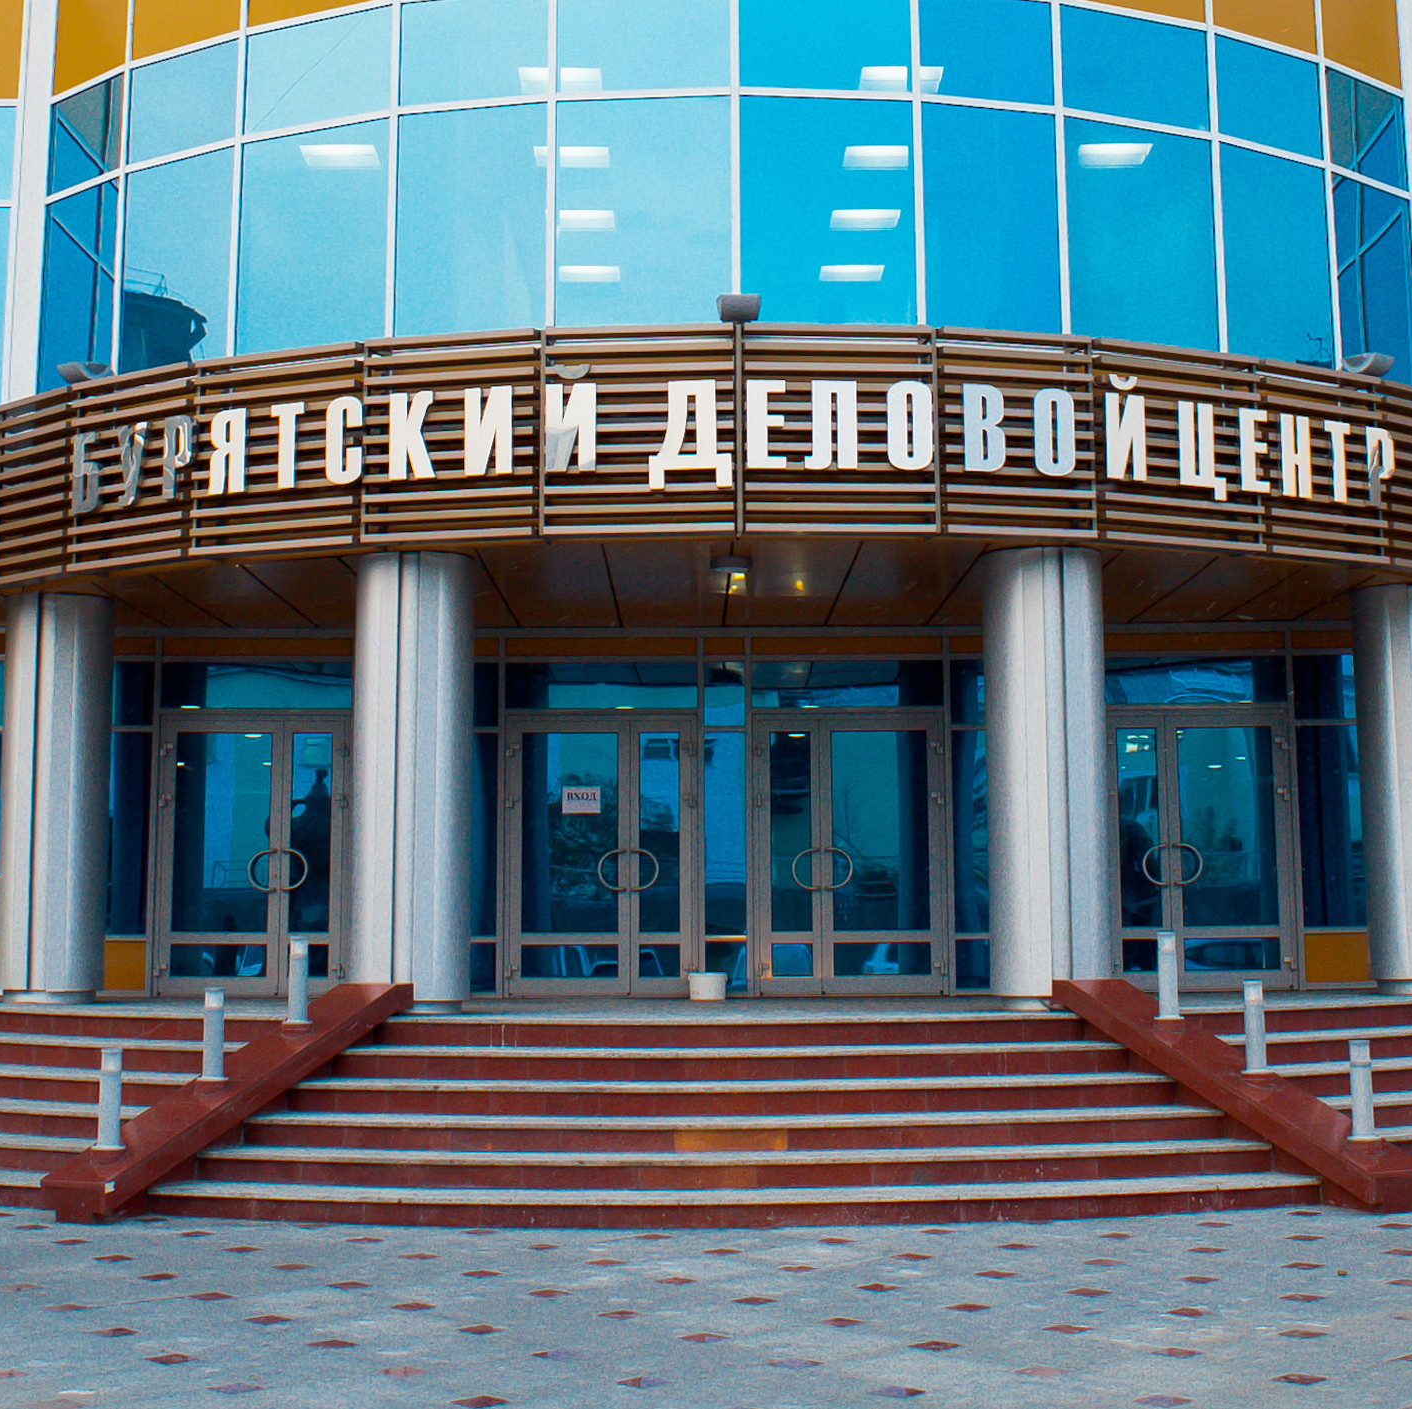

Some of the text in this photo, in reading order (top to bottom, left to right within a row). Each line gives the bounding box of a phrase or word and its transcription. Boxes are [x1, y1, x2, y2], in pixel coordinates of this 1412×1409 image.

[70, 363, 1395, 514] БУРЯТСКИЙ ДЕЛОВОЙ ЦЕНТР
[567, 791, 597, 801] ВХОД
